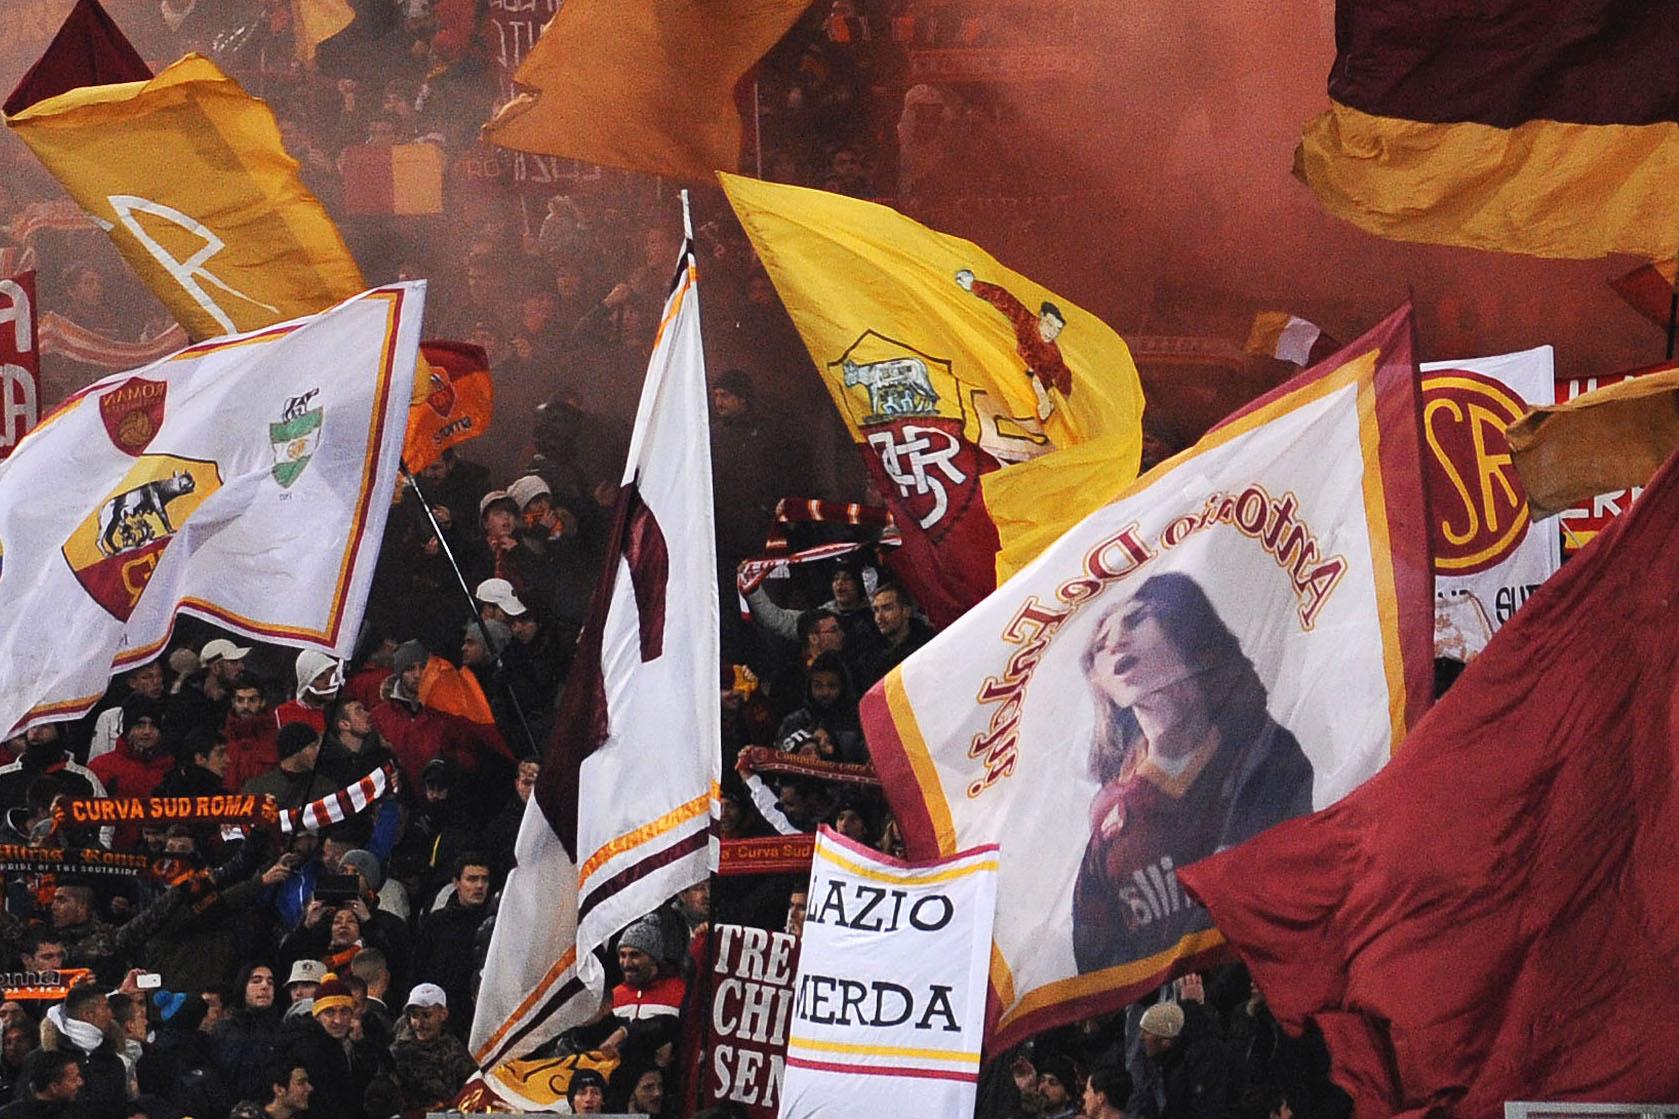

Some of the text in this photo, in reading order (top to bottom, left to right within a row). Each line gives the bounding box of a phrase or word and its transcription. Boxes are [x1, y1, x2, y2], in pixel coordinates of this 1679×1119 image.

[71, 794, 256, 821] CURVA SUD ROMA
[737, 844, 780, 859] Curva
[783, 843, 811, 858] Sud
